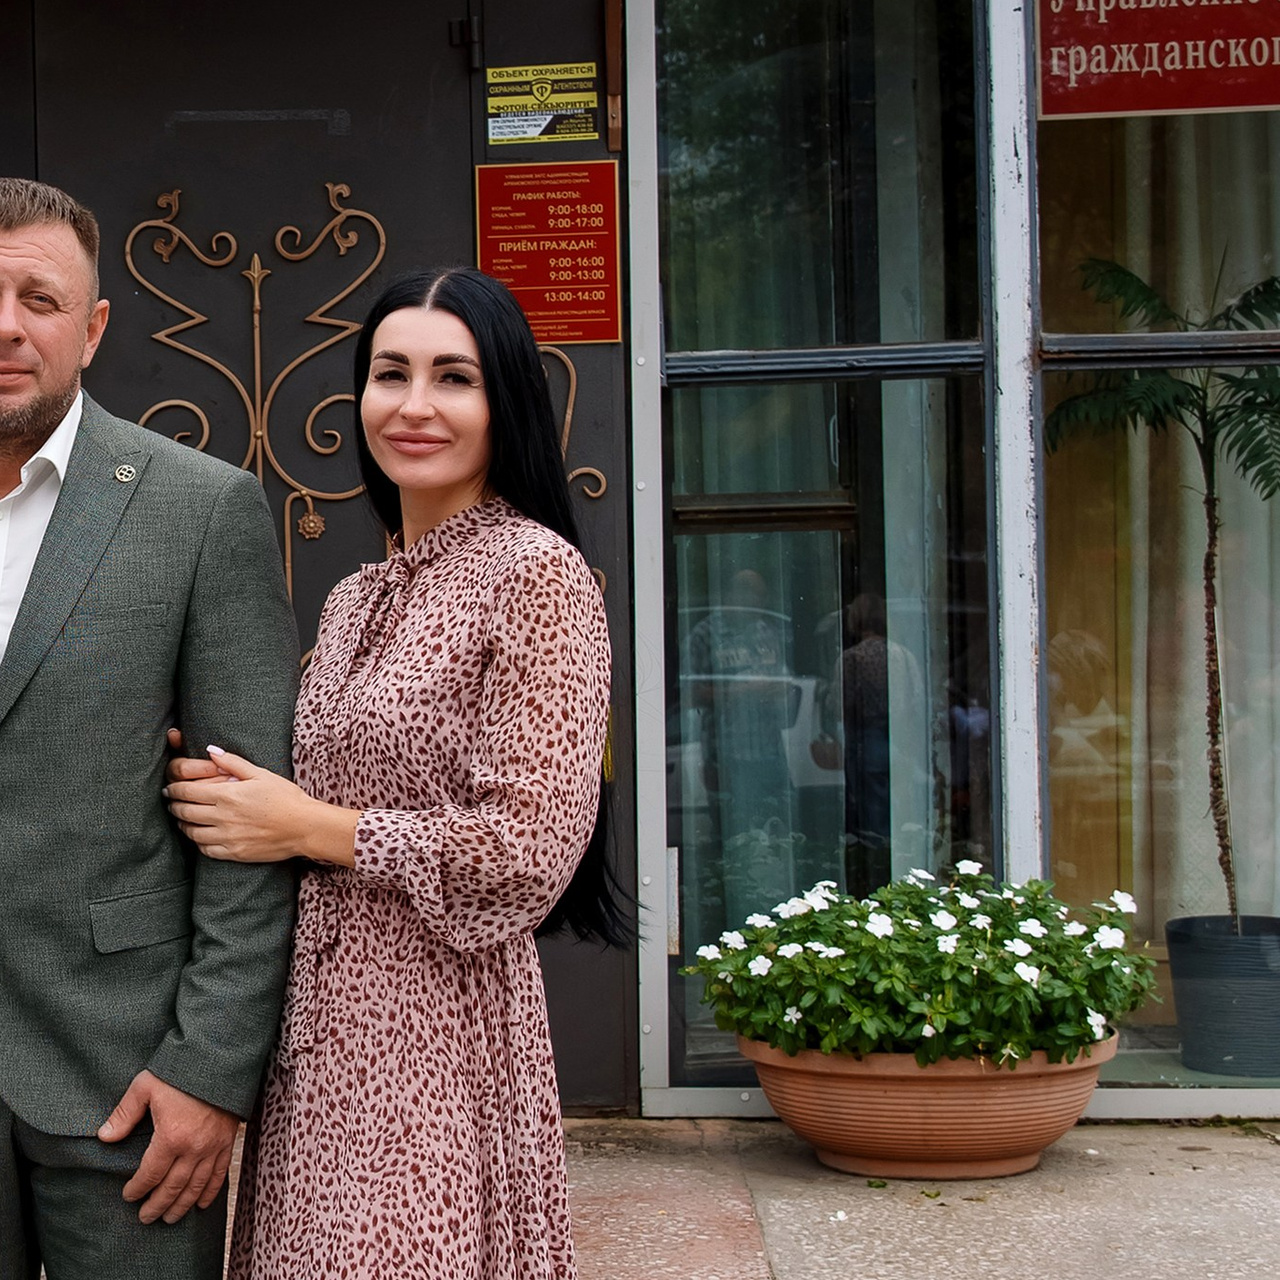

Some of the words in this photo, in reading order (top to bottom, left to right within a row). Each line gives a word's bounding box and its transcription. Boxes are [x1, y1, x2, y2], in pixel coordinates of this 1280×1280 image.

[491, 70, 529, 79] ОБЪЕКТ
[532, 66, 593, 77] ОХРАНЯЕТСЯ
[513, 192, 545, 201] ГРАФИК
[546, 191, 581, 200] РАБОТЫ:
[548, 203, 603, 215] 9:00-18:00
[548, 217, 604, 228] 9:00-17:00
[499, 239, 537, 252] ПРИЁМ
[540, 239, 597, 251] ГРАЖДАН:
[549, 256, 605, 268] 9:00-16:00
[549, 270, 605, 281] 9:00-13:00
[544, 291, 605, 302] 13:00-14:00
